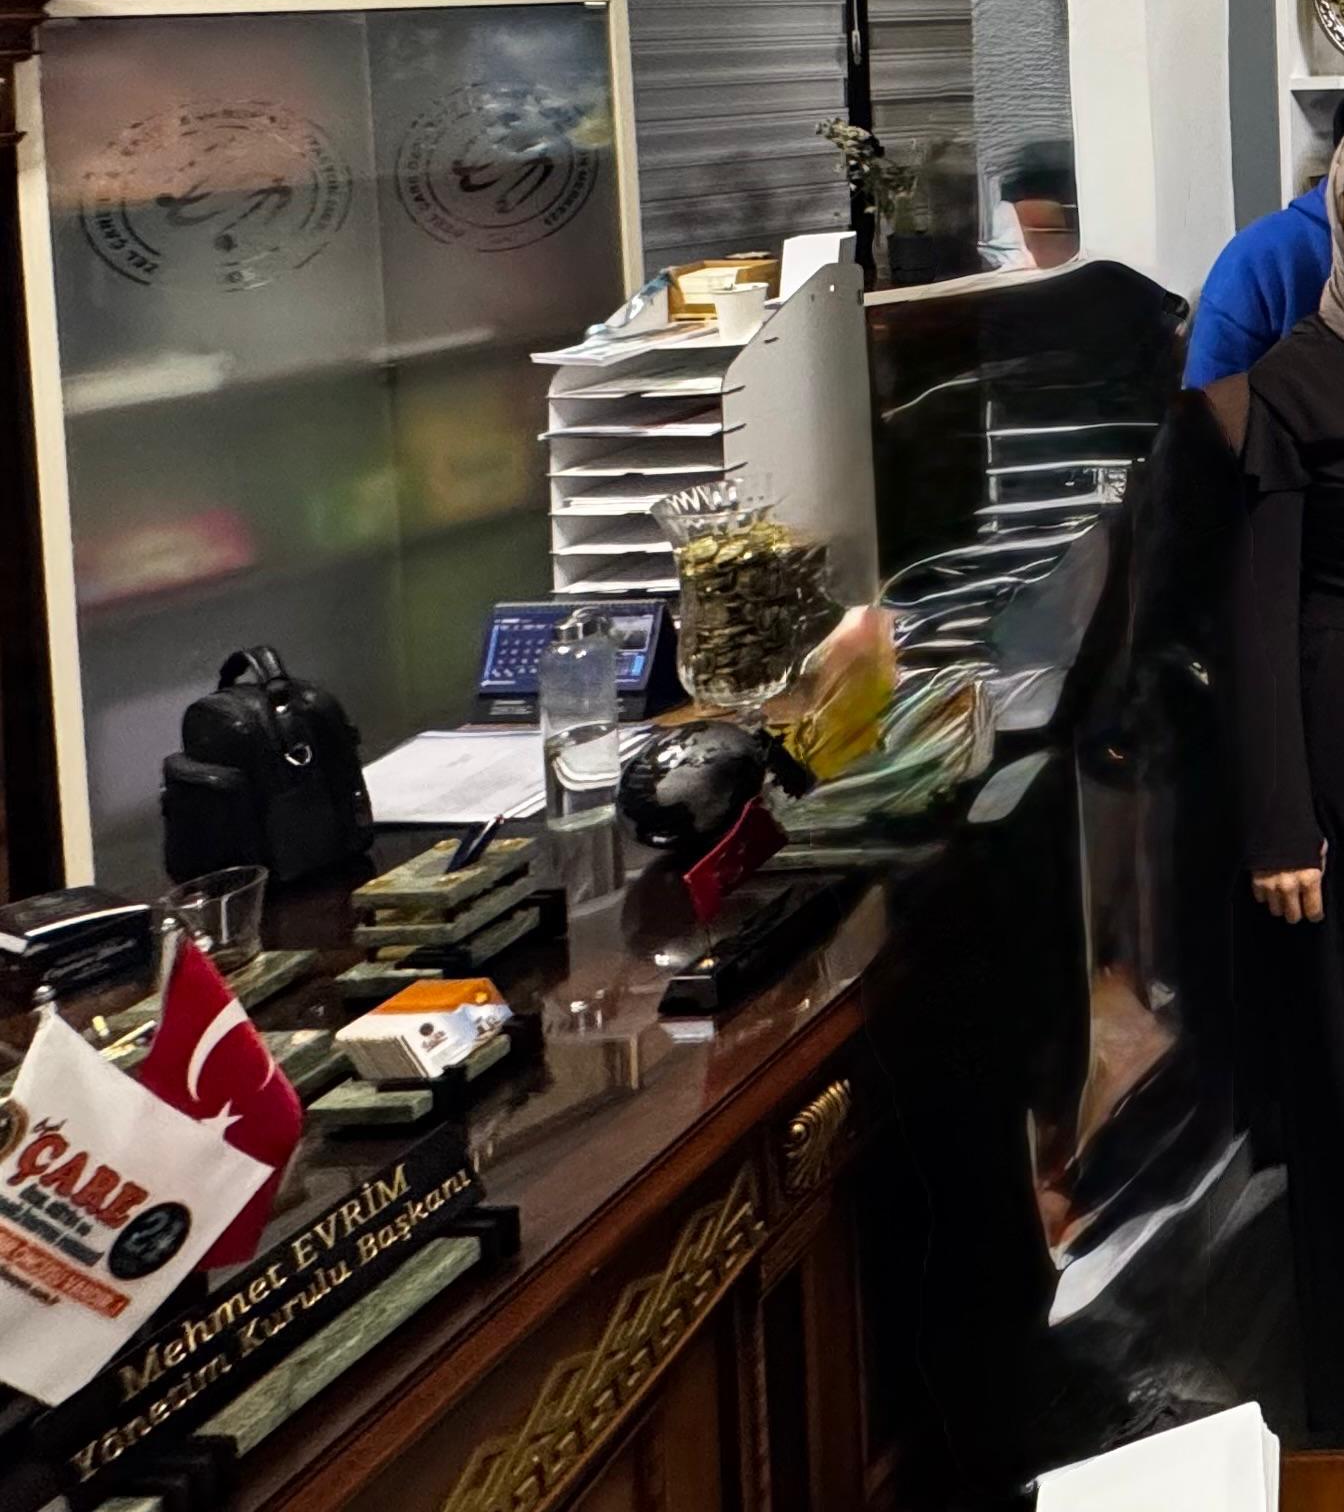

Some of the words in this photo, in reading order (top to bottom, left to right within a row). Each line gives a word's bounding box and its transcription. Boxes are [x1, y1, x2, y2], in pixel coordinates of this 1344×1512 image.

[6, 1131, 149, 1230] ÇARE
[118, 1262, 288, 1404] Mehmet
[291, 1162, 412, 1273] EVRİM
[68, 1354, 233, 1483] Yönetim
[237, 1260, 352, 1358] Kurulu
[356, 1168, 472, 1267] Başkanı
